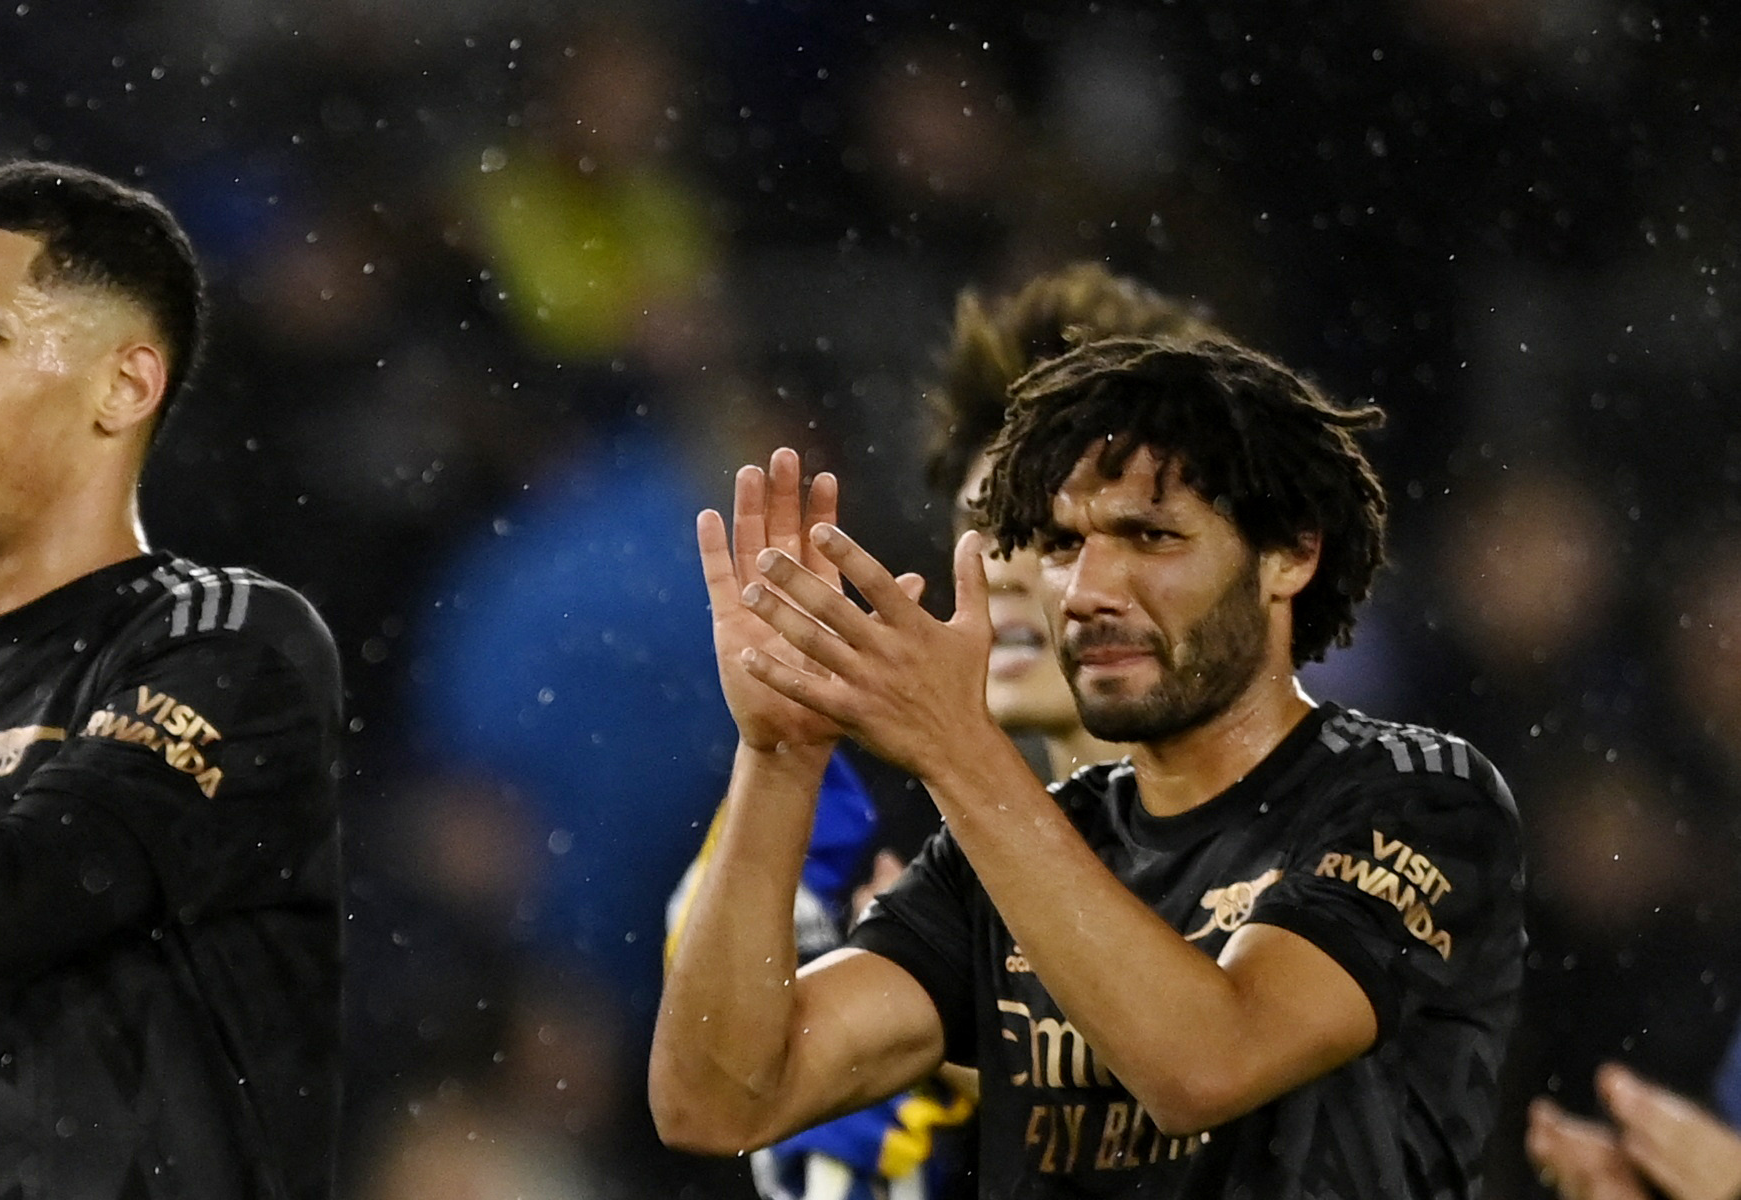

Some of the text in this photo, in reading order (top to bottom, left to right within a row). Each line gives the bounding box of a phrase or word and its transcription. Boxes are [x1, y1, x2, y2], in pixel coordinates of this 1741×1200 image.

[79, 710, 224, 799] RWANDA
[136, 685, 222, 746] VISIT
[1315, 852, 1452, 961] RWANDA
[1372, 829, 1452, 906] VISIT
